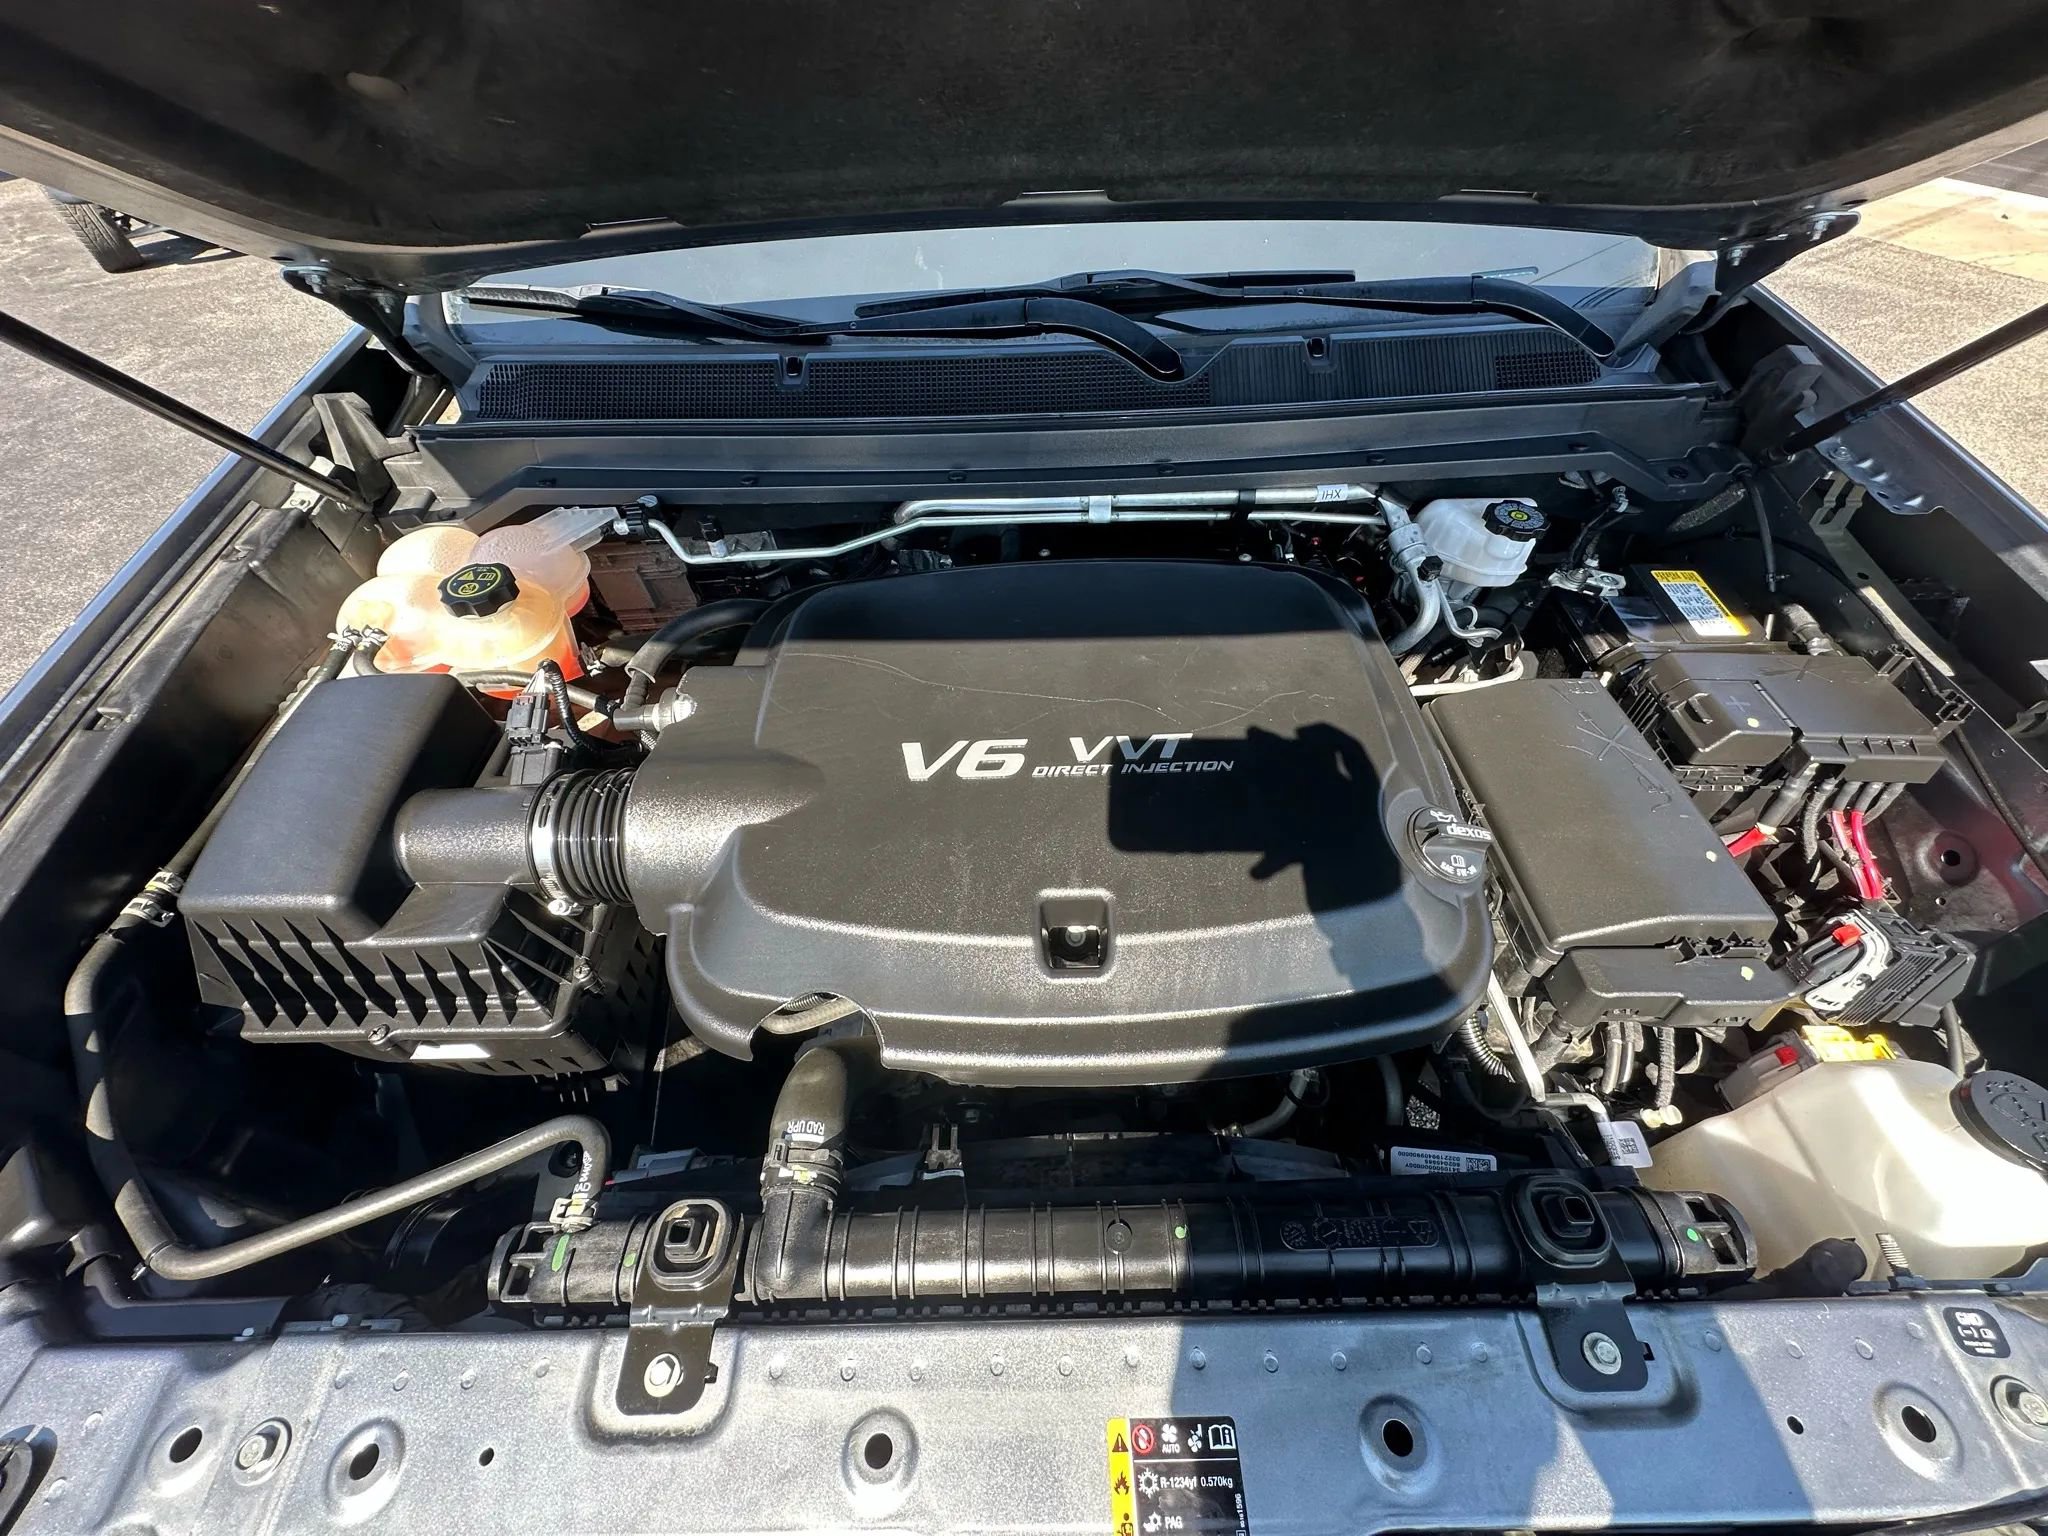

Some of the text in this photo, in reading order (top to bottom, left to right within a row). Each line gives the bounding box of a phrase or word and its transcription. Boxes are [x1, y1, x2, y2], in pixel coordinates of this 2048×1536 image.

[1069, 732, 1194, 762] VVT
[901, 738, 1029, 782] V6
[1031, 760, 1235, 778] DIRECT INJECTION
[1446, 823, 1492, 840] dexos
[787, 1120, 825, 1135] RAD UPR
[1161, 1443, 1181, 1454] AUTO
[1160, 1476, 1234, 1490] R-1234yf 0.570kg
[1164, 1515, 1184, 1530] PAG
